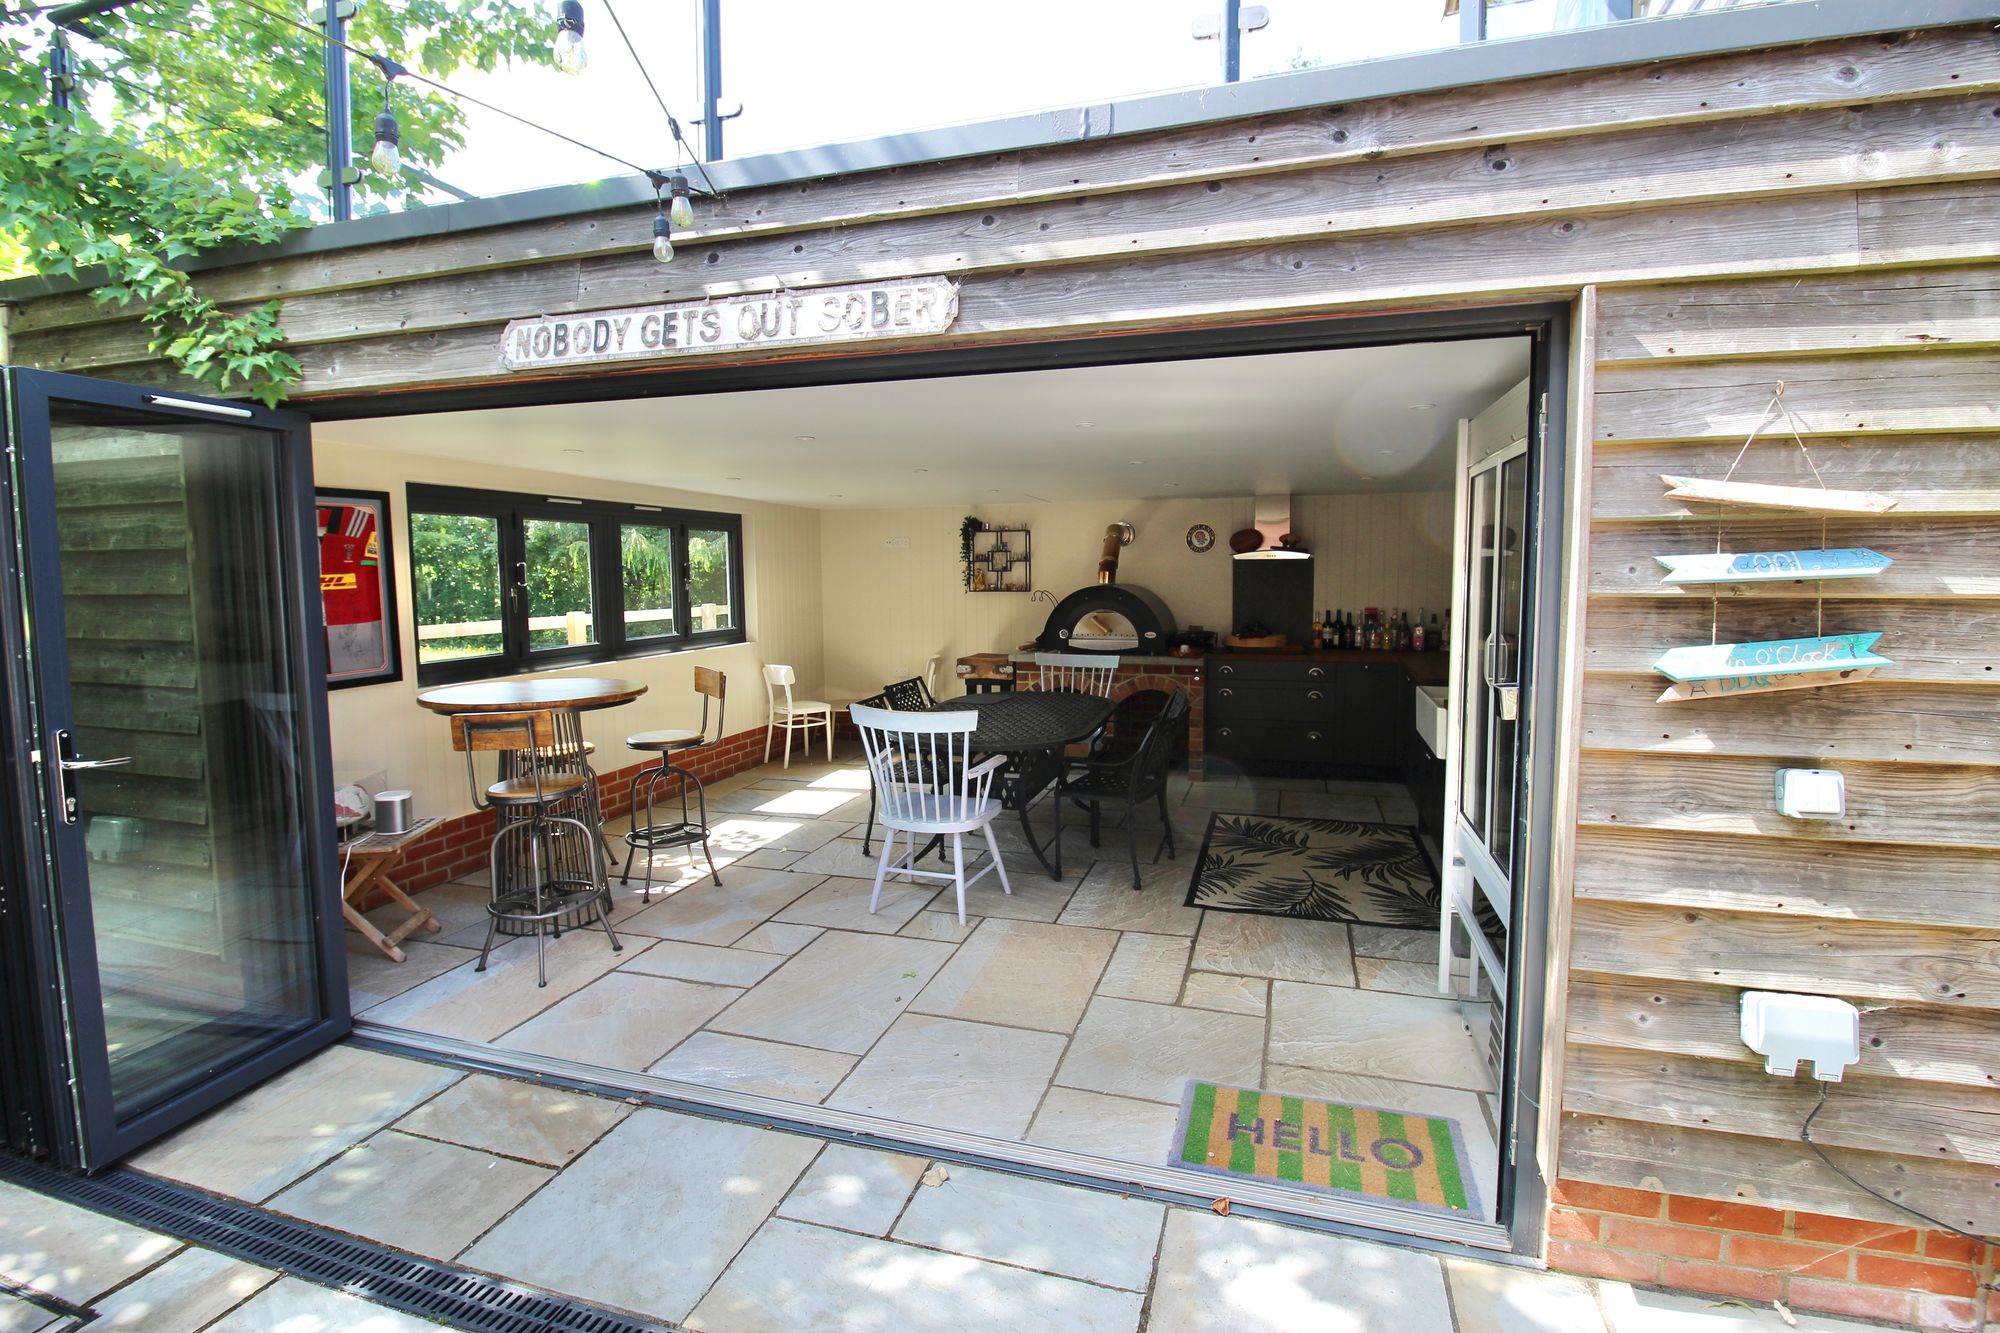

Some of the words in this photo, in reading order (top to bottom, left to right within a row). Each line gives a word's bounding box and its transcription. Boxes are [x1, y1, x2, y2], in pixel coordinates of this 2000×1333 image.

[516, 317, 632, 360] NOBODY
[640, 308, 721, 349] GETS
[738, 297, 804, 341] OUT
[817, 286, 938, 332] SOBER
[320, 576, 347, 587] HL
[1227, 1112, 1424, 1170] HELLO
